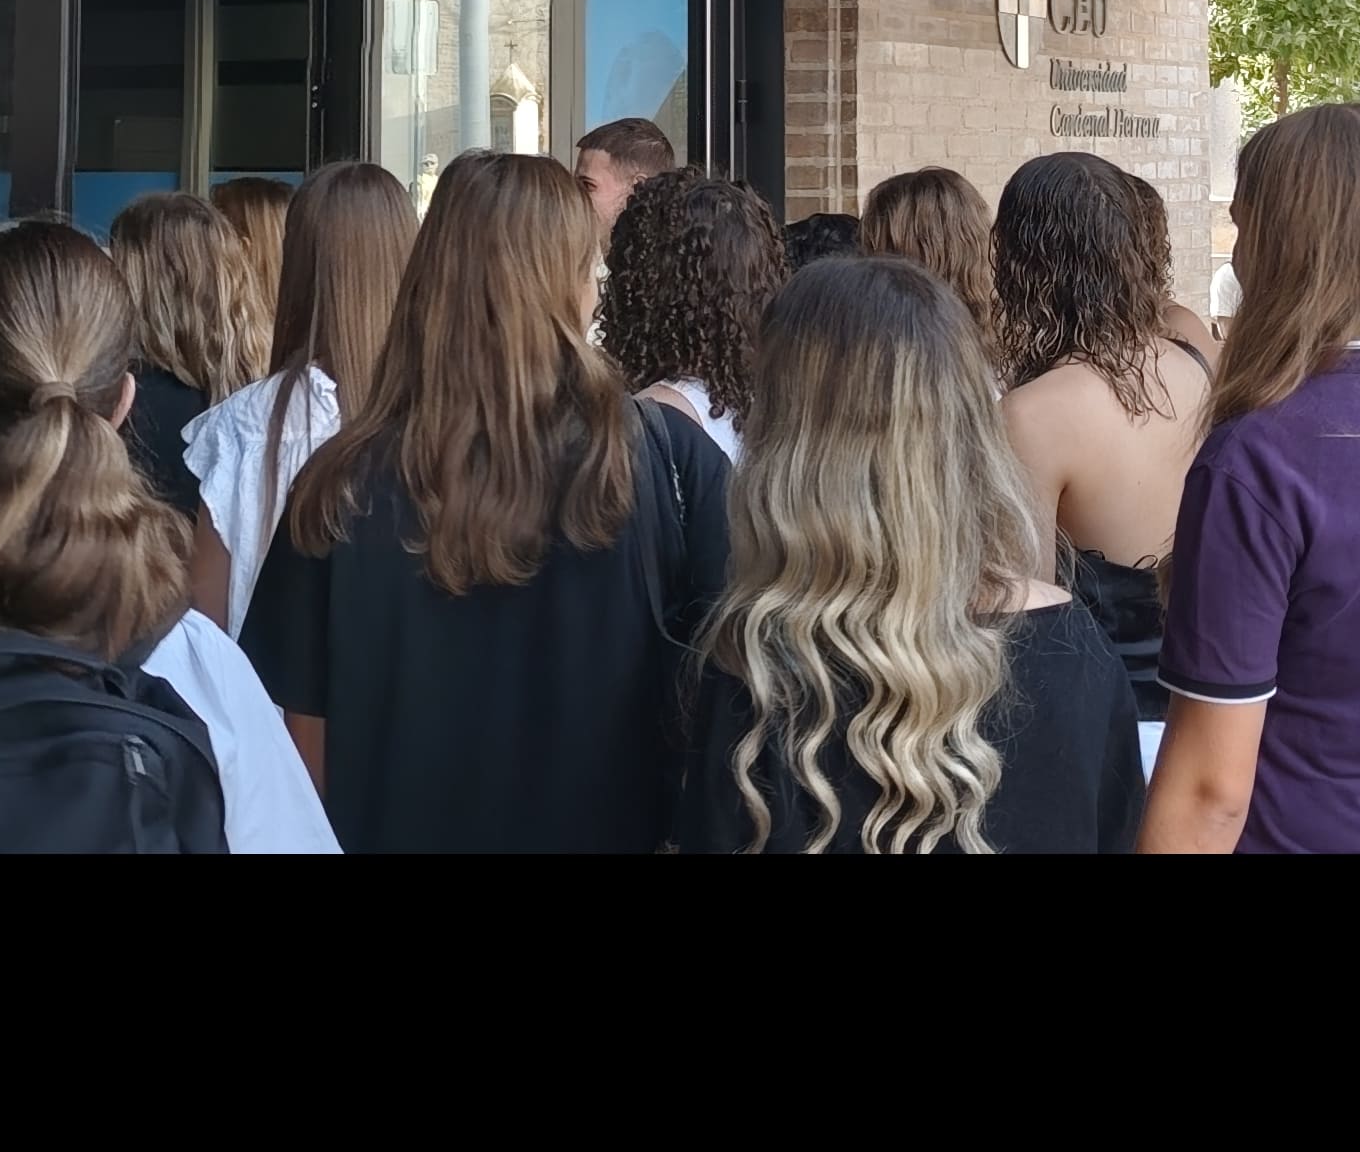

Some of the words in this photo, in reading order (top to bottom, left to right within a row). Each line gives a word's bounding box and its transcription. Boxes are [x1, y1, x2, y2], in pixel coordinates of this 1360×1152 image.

[1049, 57, 1128, 93] Universidad
[1049, 102, 1111, 138] Cardenal
[1112, 108, 1161, 140] Herrera
